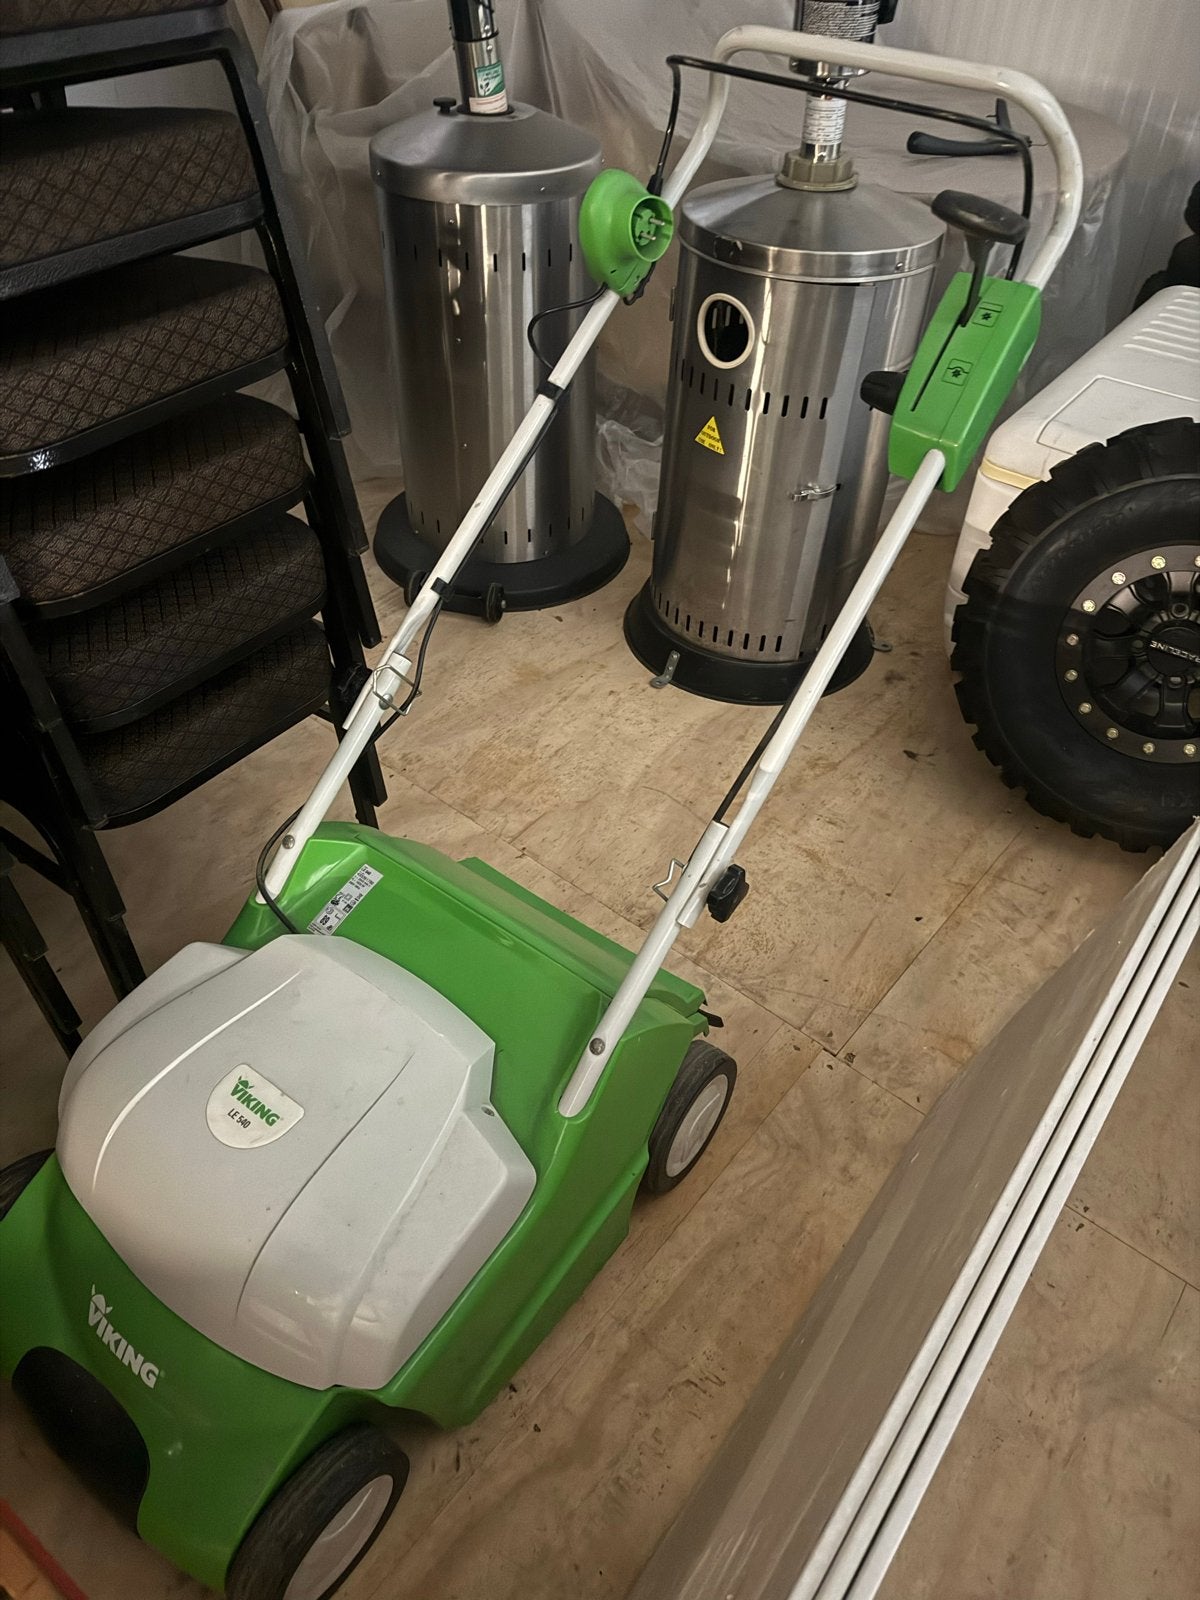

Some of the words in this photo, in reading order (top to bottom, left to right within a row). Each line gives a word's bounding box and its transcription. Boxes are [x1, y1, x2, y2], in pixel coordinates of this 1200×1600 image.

[227, 1108, 238, 1120] LE
[237, 1115, 251, 1128] 540
[230, 1080, 280, 1126] VIKING
[88, 1297, 159, 1389] VIKING
